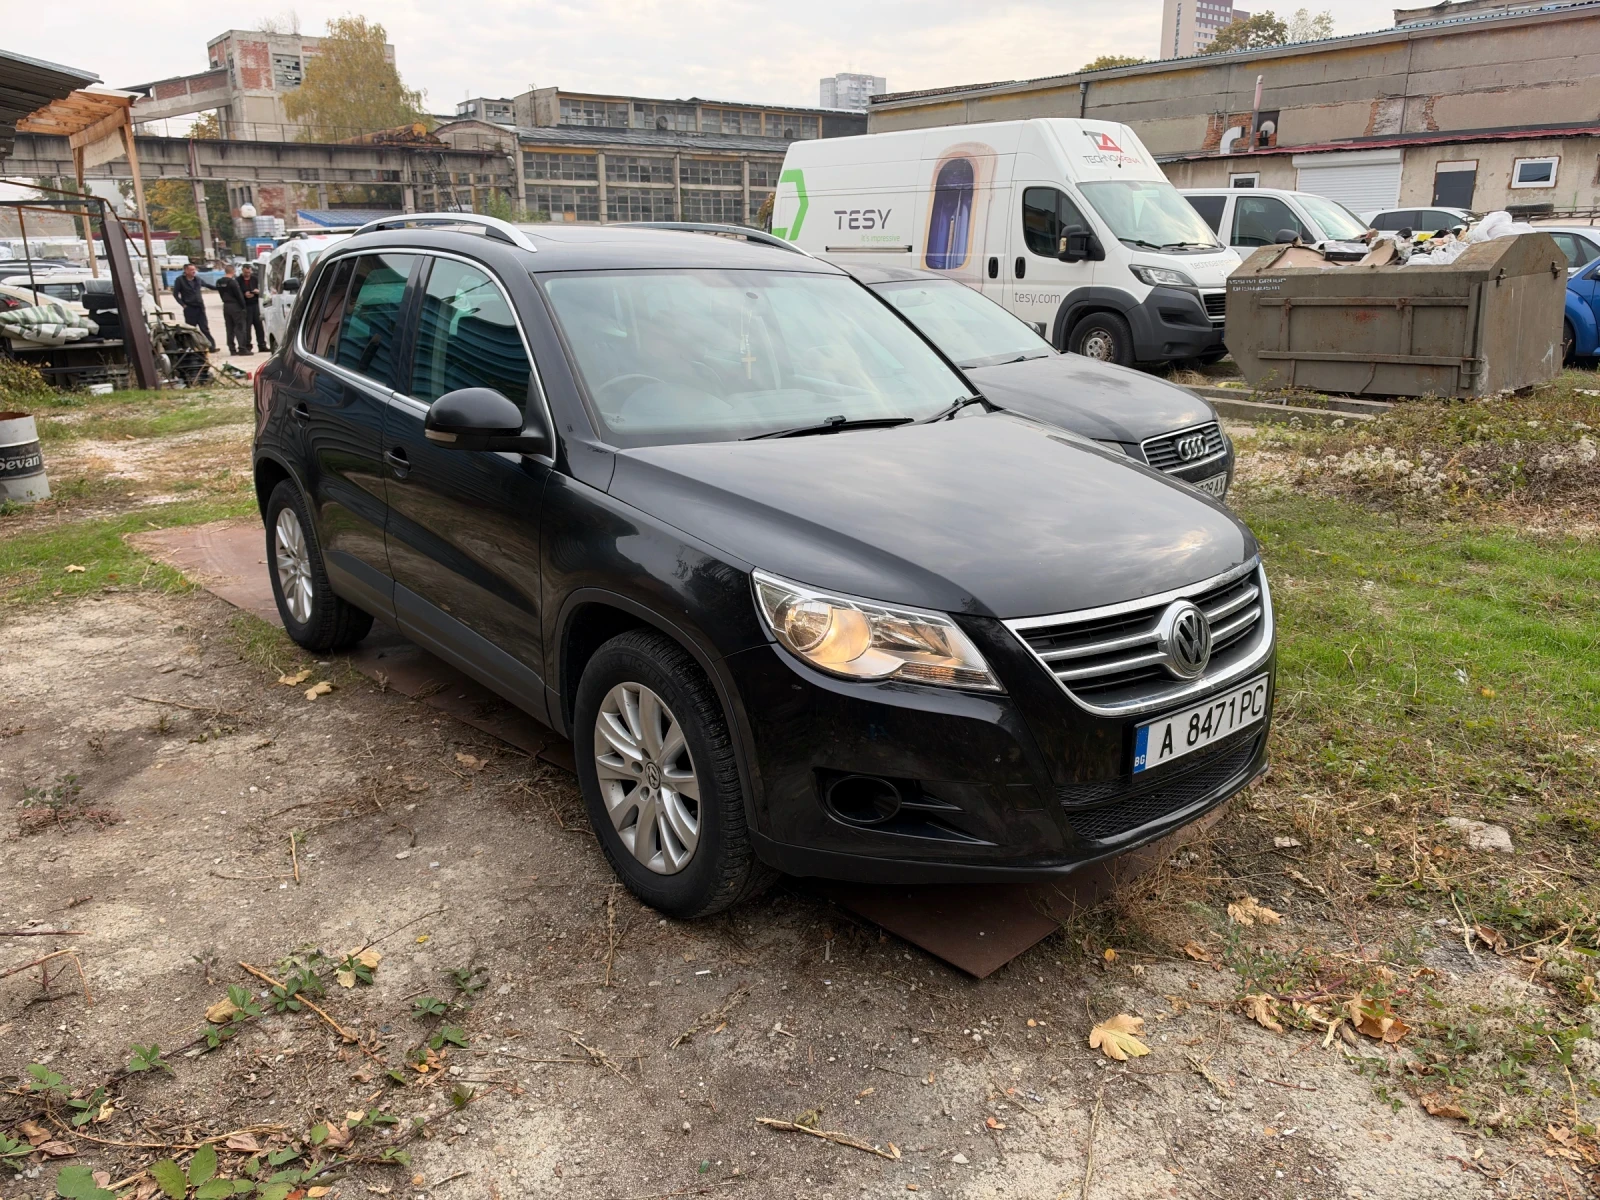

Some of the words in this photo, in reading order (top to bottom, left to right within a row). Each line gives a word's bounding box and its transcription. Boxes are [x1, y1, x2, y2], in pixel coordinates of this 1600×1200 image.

[834, 208, 892, 230] TESY
[871, 234, 900, 243] impressive
[1014, 291, 1061, 307] tesy.com
[1159, 722, 1173, 759] A
[1133, 754, 1147, 768] BG
